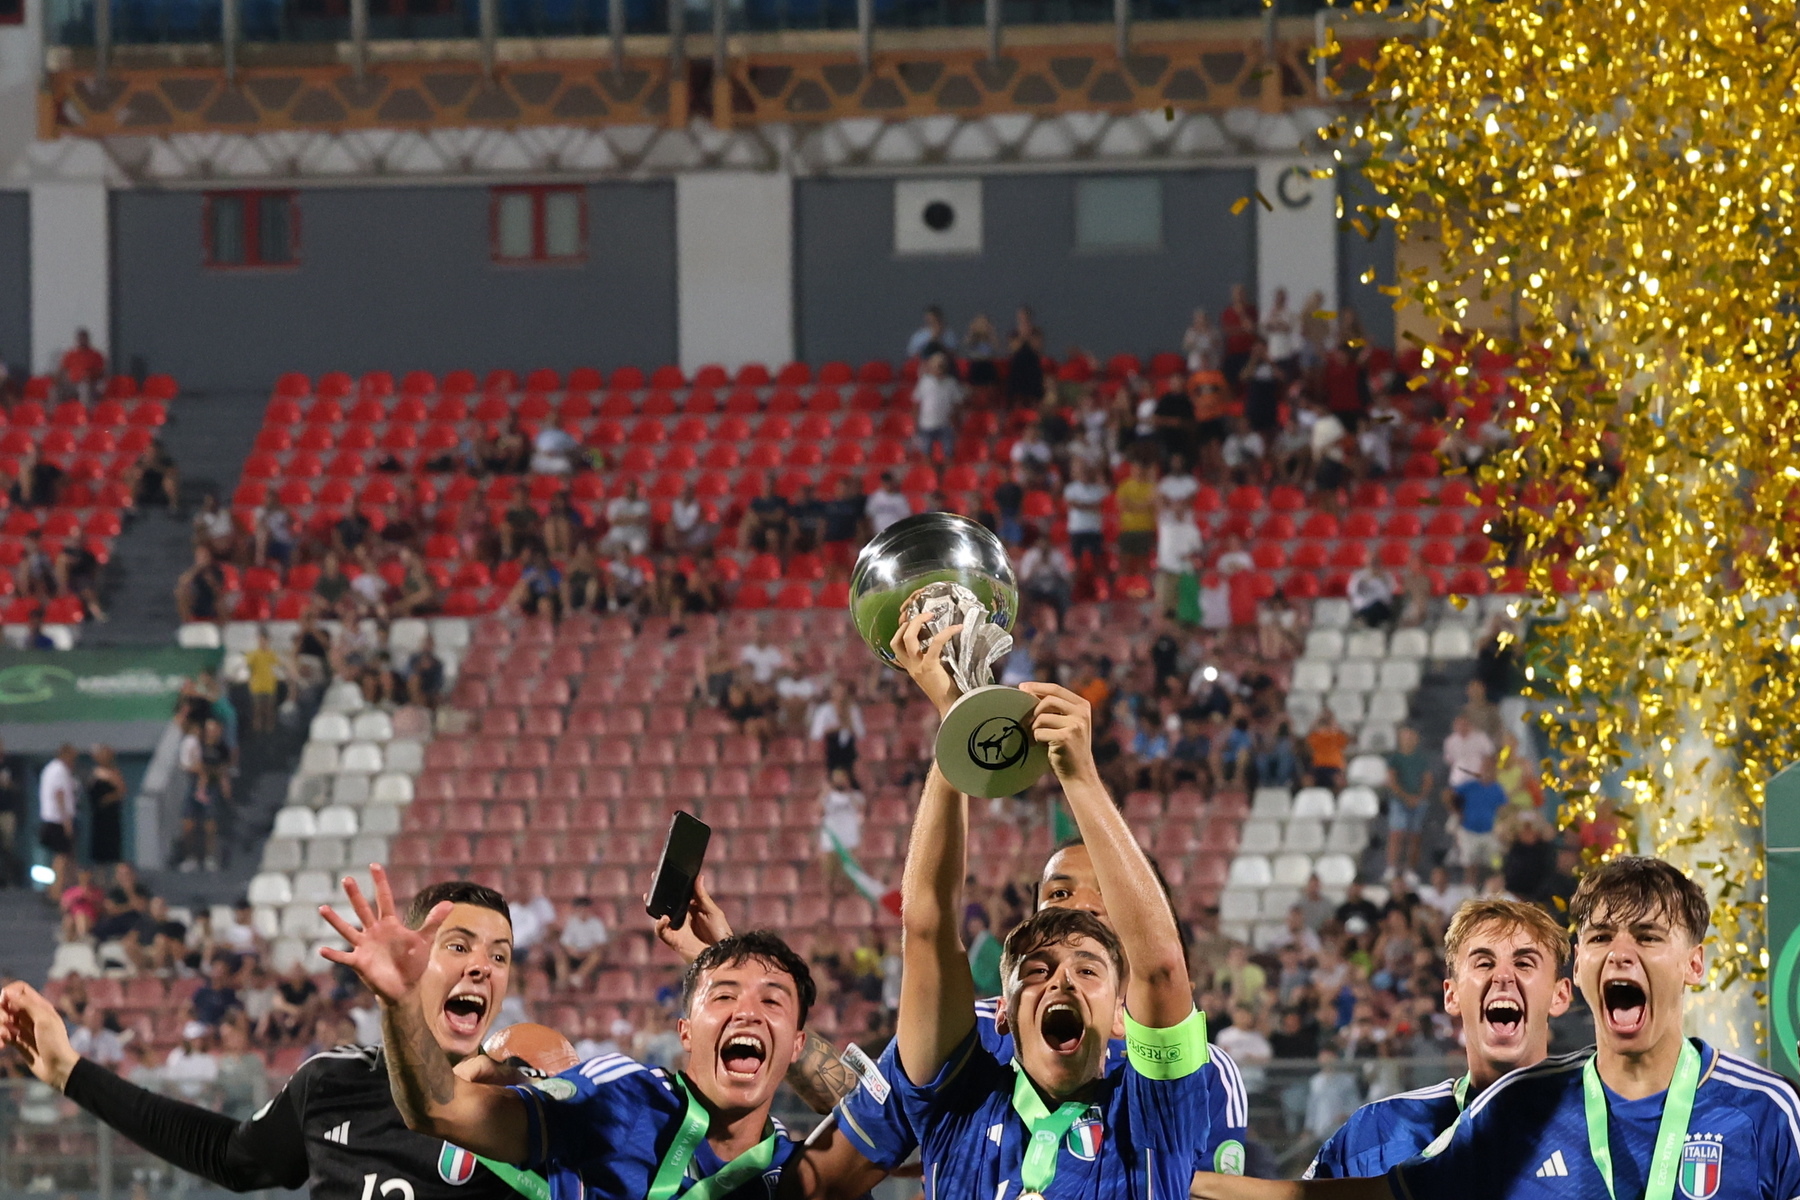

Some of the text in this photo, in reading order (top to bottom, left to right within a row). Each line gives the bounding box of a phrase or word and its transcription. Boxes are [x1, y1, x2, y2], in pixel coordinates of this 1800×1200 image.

[1276, 165, 1312, 208] C
[670, 1144, 689, 1167] 2023
[1657, 1132, 1676, 1186] MALTA 2023
[1685, 1146, 1718, 1159] ITALIA
